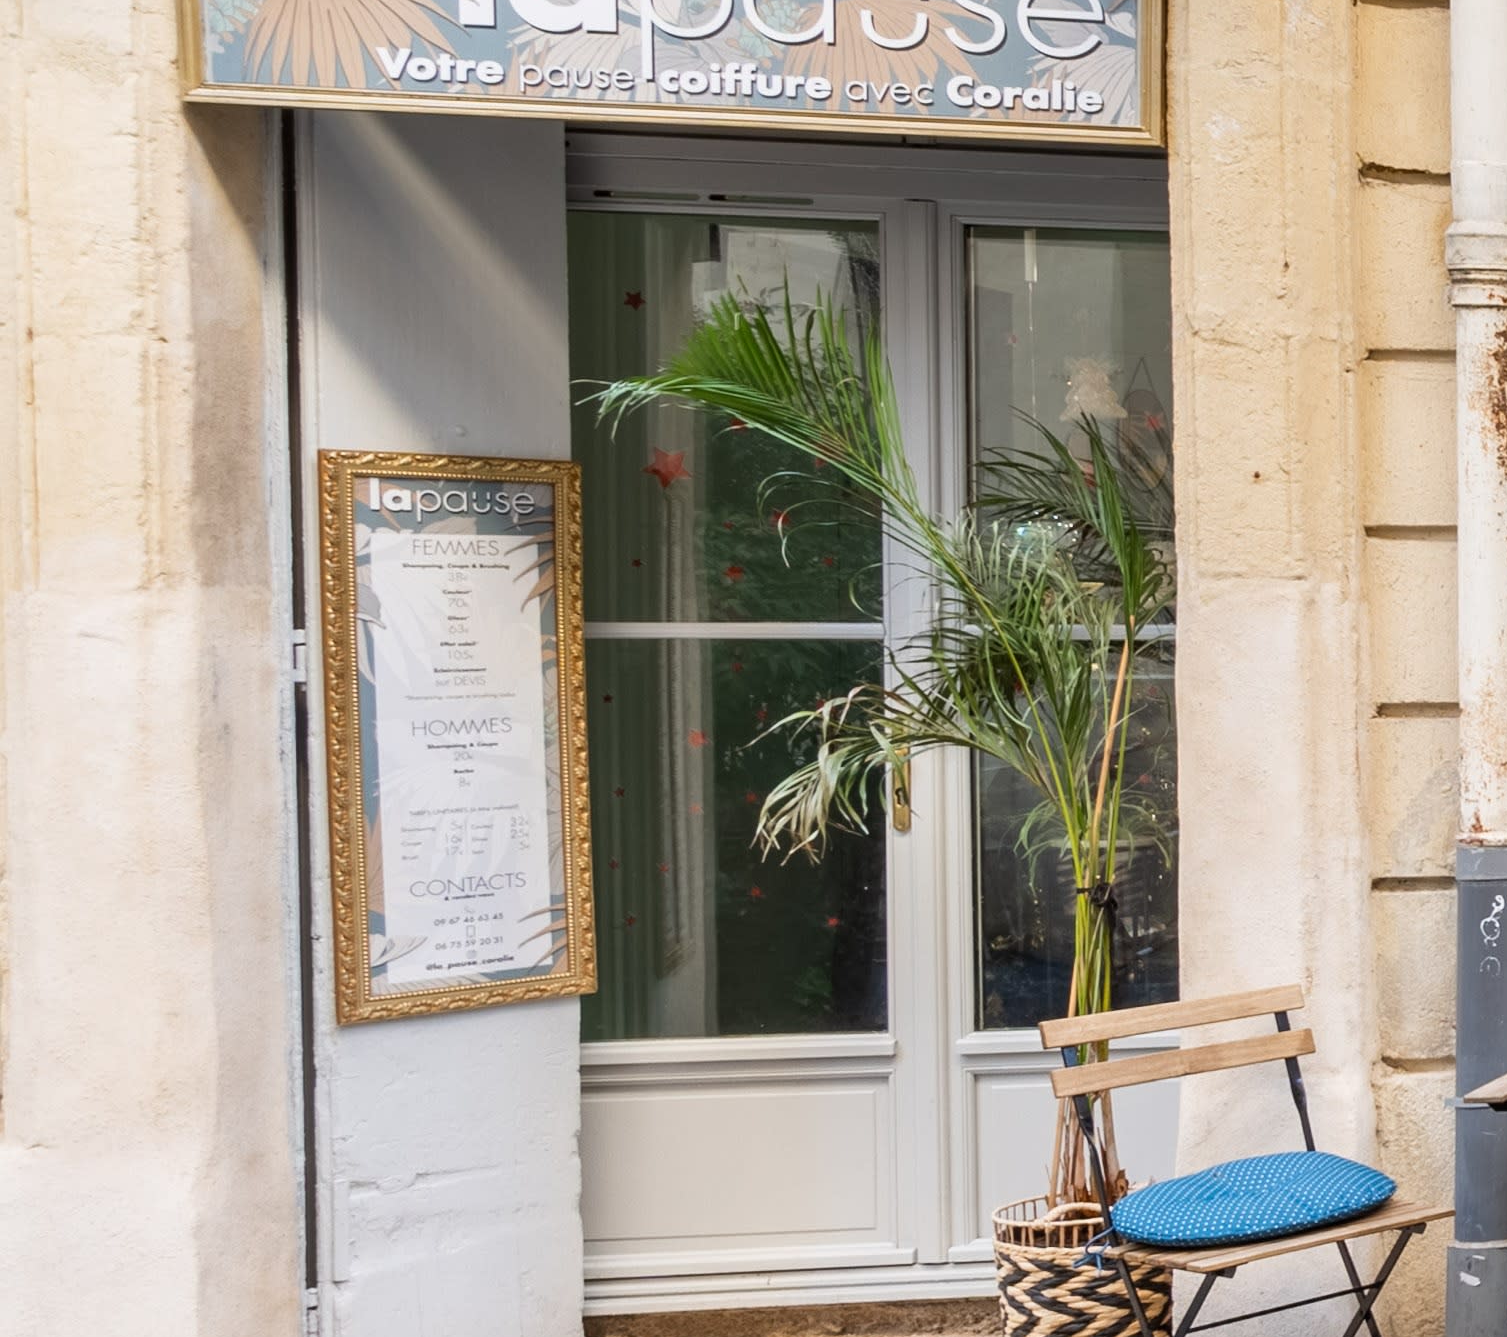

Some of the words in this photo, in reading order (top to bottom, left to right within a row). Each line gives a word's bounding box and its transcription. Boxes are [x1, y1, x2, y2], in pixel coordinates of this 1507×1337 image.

[374, 46, 505, 87] Votre
[518, 61, 637, 95] pause
[659, 64, 833, 101] coiffure
[844, 76, 934, 106] avec
[946, 74, 1105, 115] Coralie
[412, 539, 500, 557] FEMMES
[454, 676, 486, 687] DEVIS
[411, 717, 513, 737] HOMMES
[409, 871, 527, 898] CONTACTS
